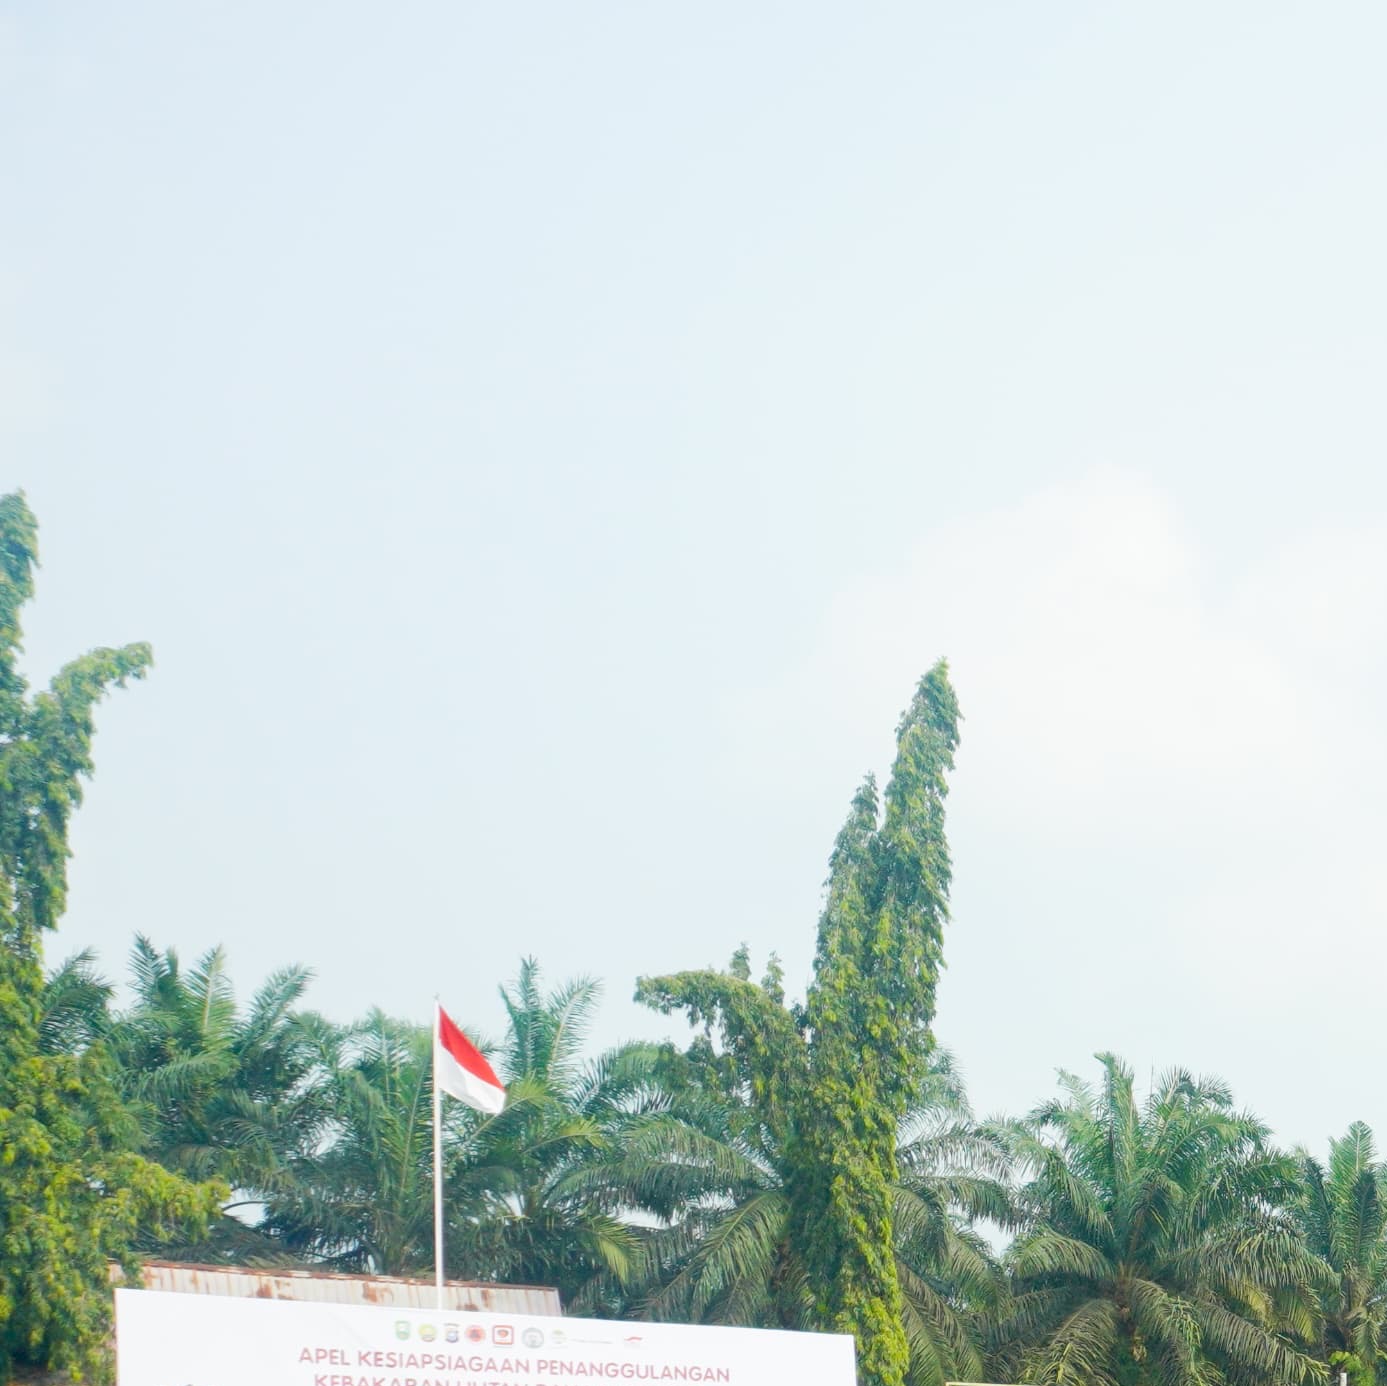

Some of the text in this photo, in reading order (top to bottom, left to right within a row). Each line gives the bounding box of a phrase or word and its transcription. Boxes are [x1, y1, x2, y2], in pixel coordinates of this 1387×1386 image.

[299, 1347, 730, 1383] APEL KESIAPSIAGAAN PENANGGULANGAN
